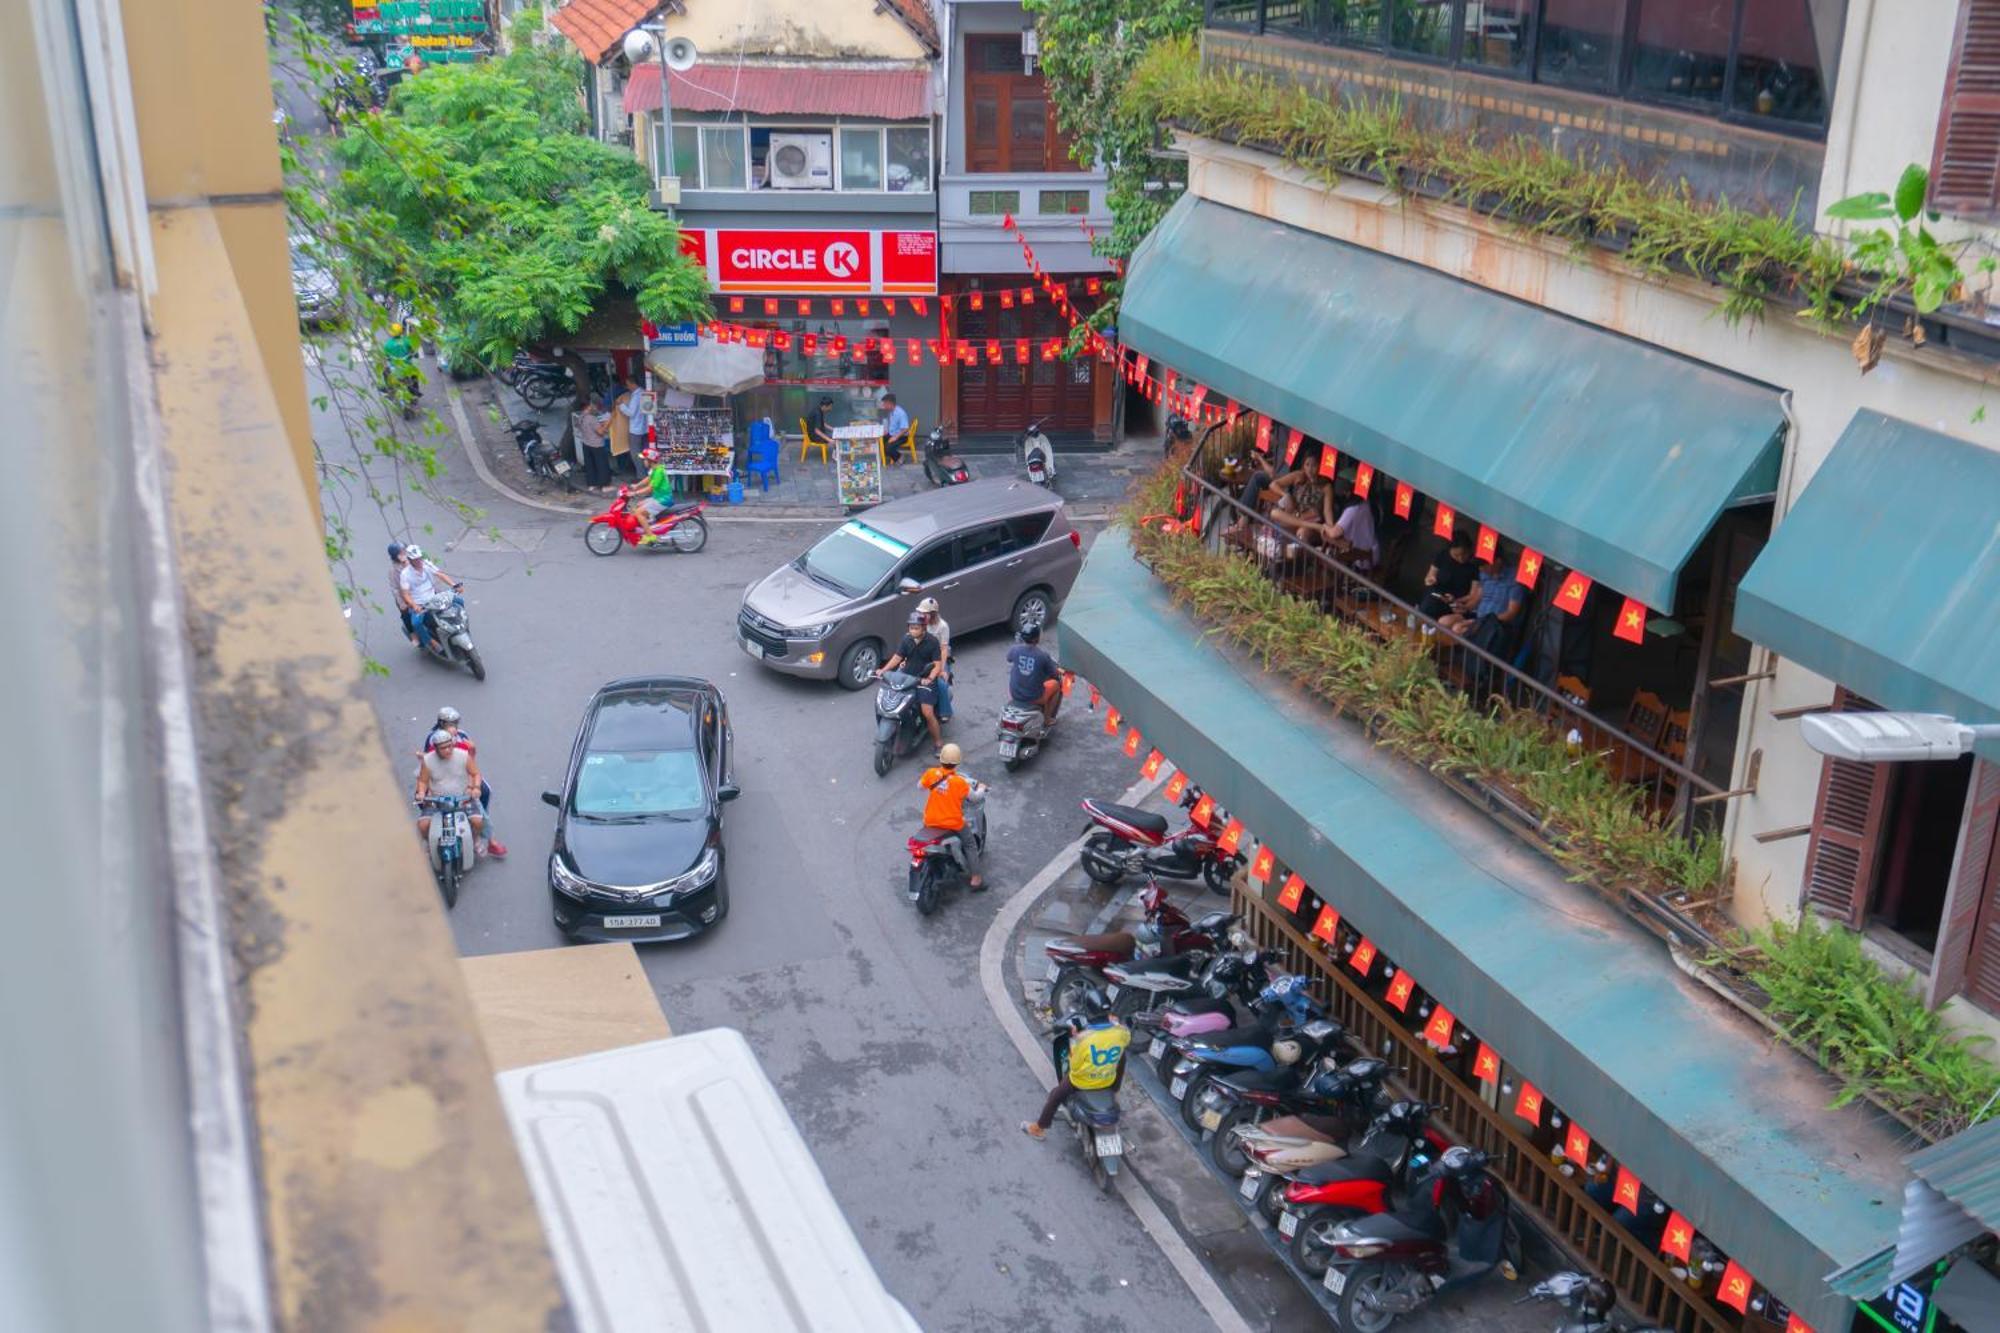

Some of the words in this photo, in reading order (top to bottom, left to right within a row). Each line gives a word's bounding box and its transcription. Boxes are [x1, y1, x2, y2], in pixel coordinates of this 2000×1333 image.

[731, 249, 816, 270] CIRCLE
[829, 244, 858, 277] K
[1017, 655, 1035, 671] 58
[1089, 1044, 1121, 1067] be
